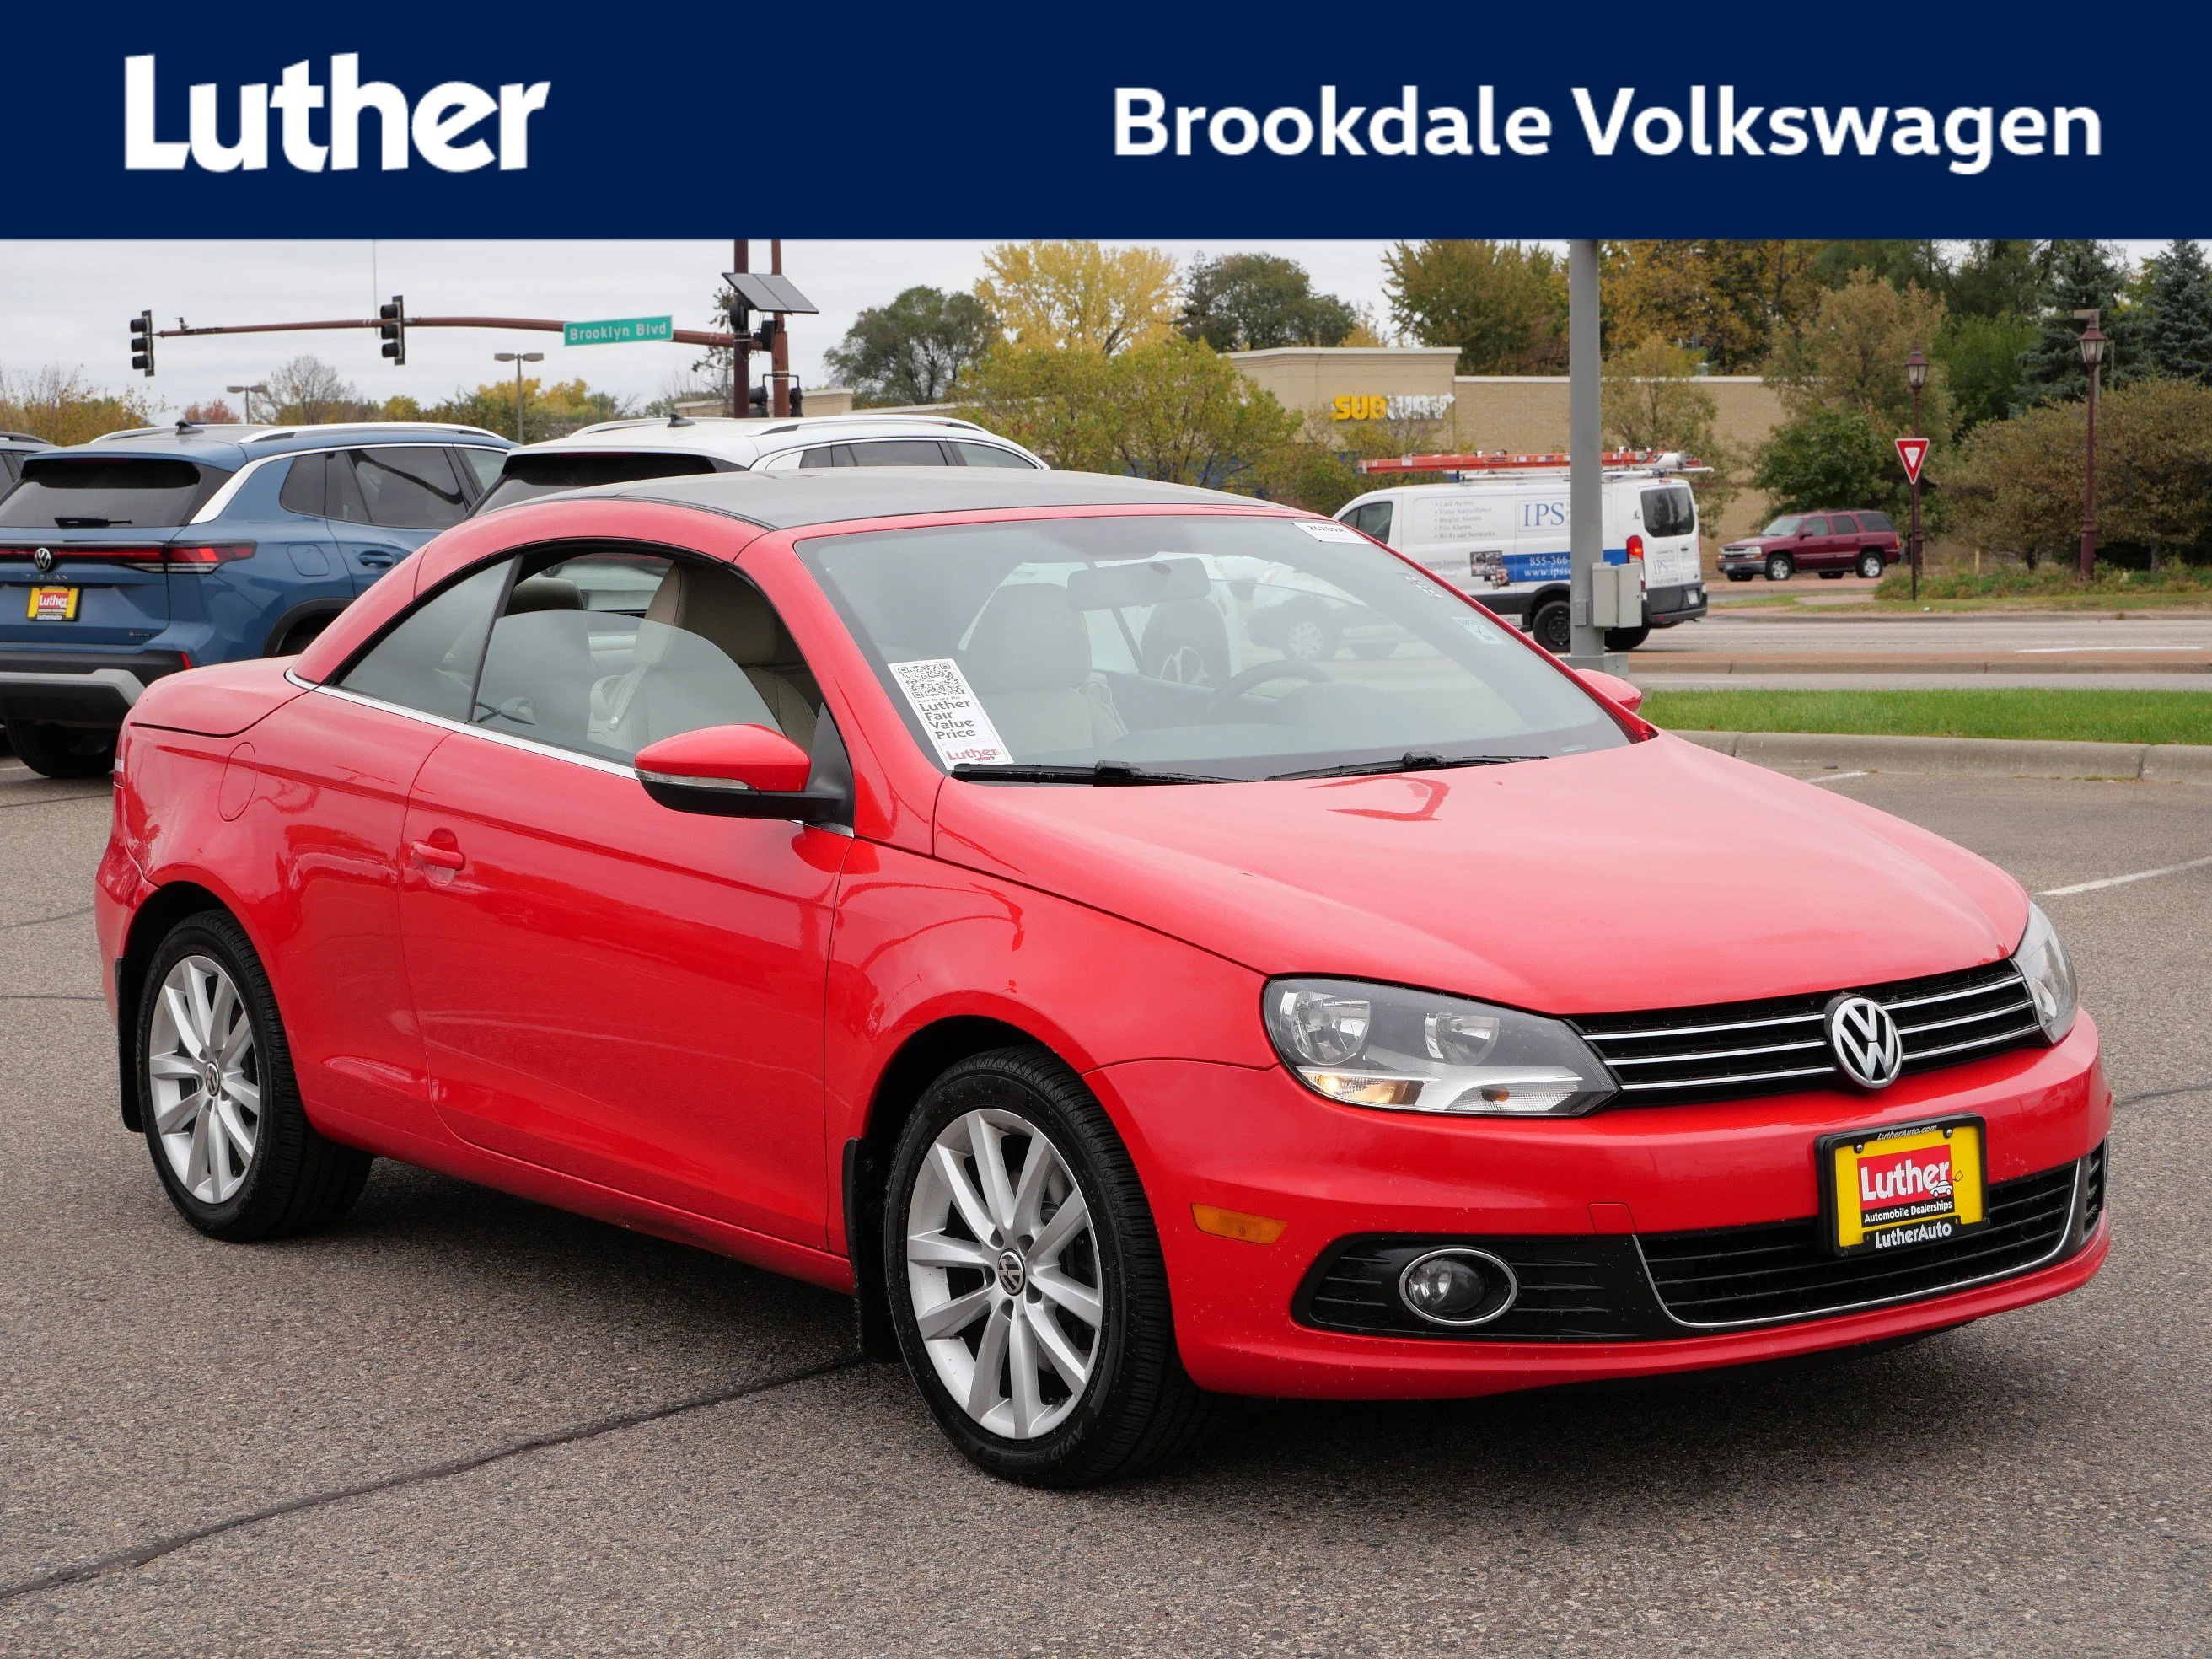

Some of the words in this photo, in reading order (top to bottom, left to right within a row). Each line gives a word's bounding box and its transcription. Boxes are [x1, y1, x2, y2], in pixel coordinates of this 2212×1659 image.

[569, 326, 630, 341] Brooklyn
[636, 322, 667, 336] Blvd
[1522, 502, 1565, 527] IPS
[1529, 556, 1570, 566] 855-366-
[39, 594, 68, 607] Luther
[919, 701, 970, 711] Luther
[924, 710, 953, 721] Fair
[928, 719, 974, 729] Value
[935, 729, 976, 740] Price
[946, 748, 997, 760] Luther
[1876, 1125, 1937, 1141] LutherAuto.com
[1860, 1159, 1950, 1201] Luther
[1864, 1207, 1909, 1224] Automobile
[1910, 1200, 1952, 1216] Dealerships
[1875, 1221, 1952, 1249] LutherAuto
